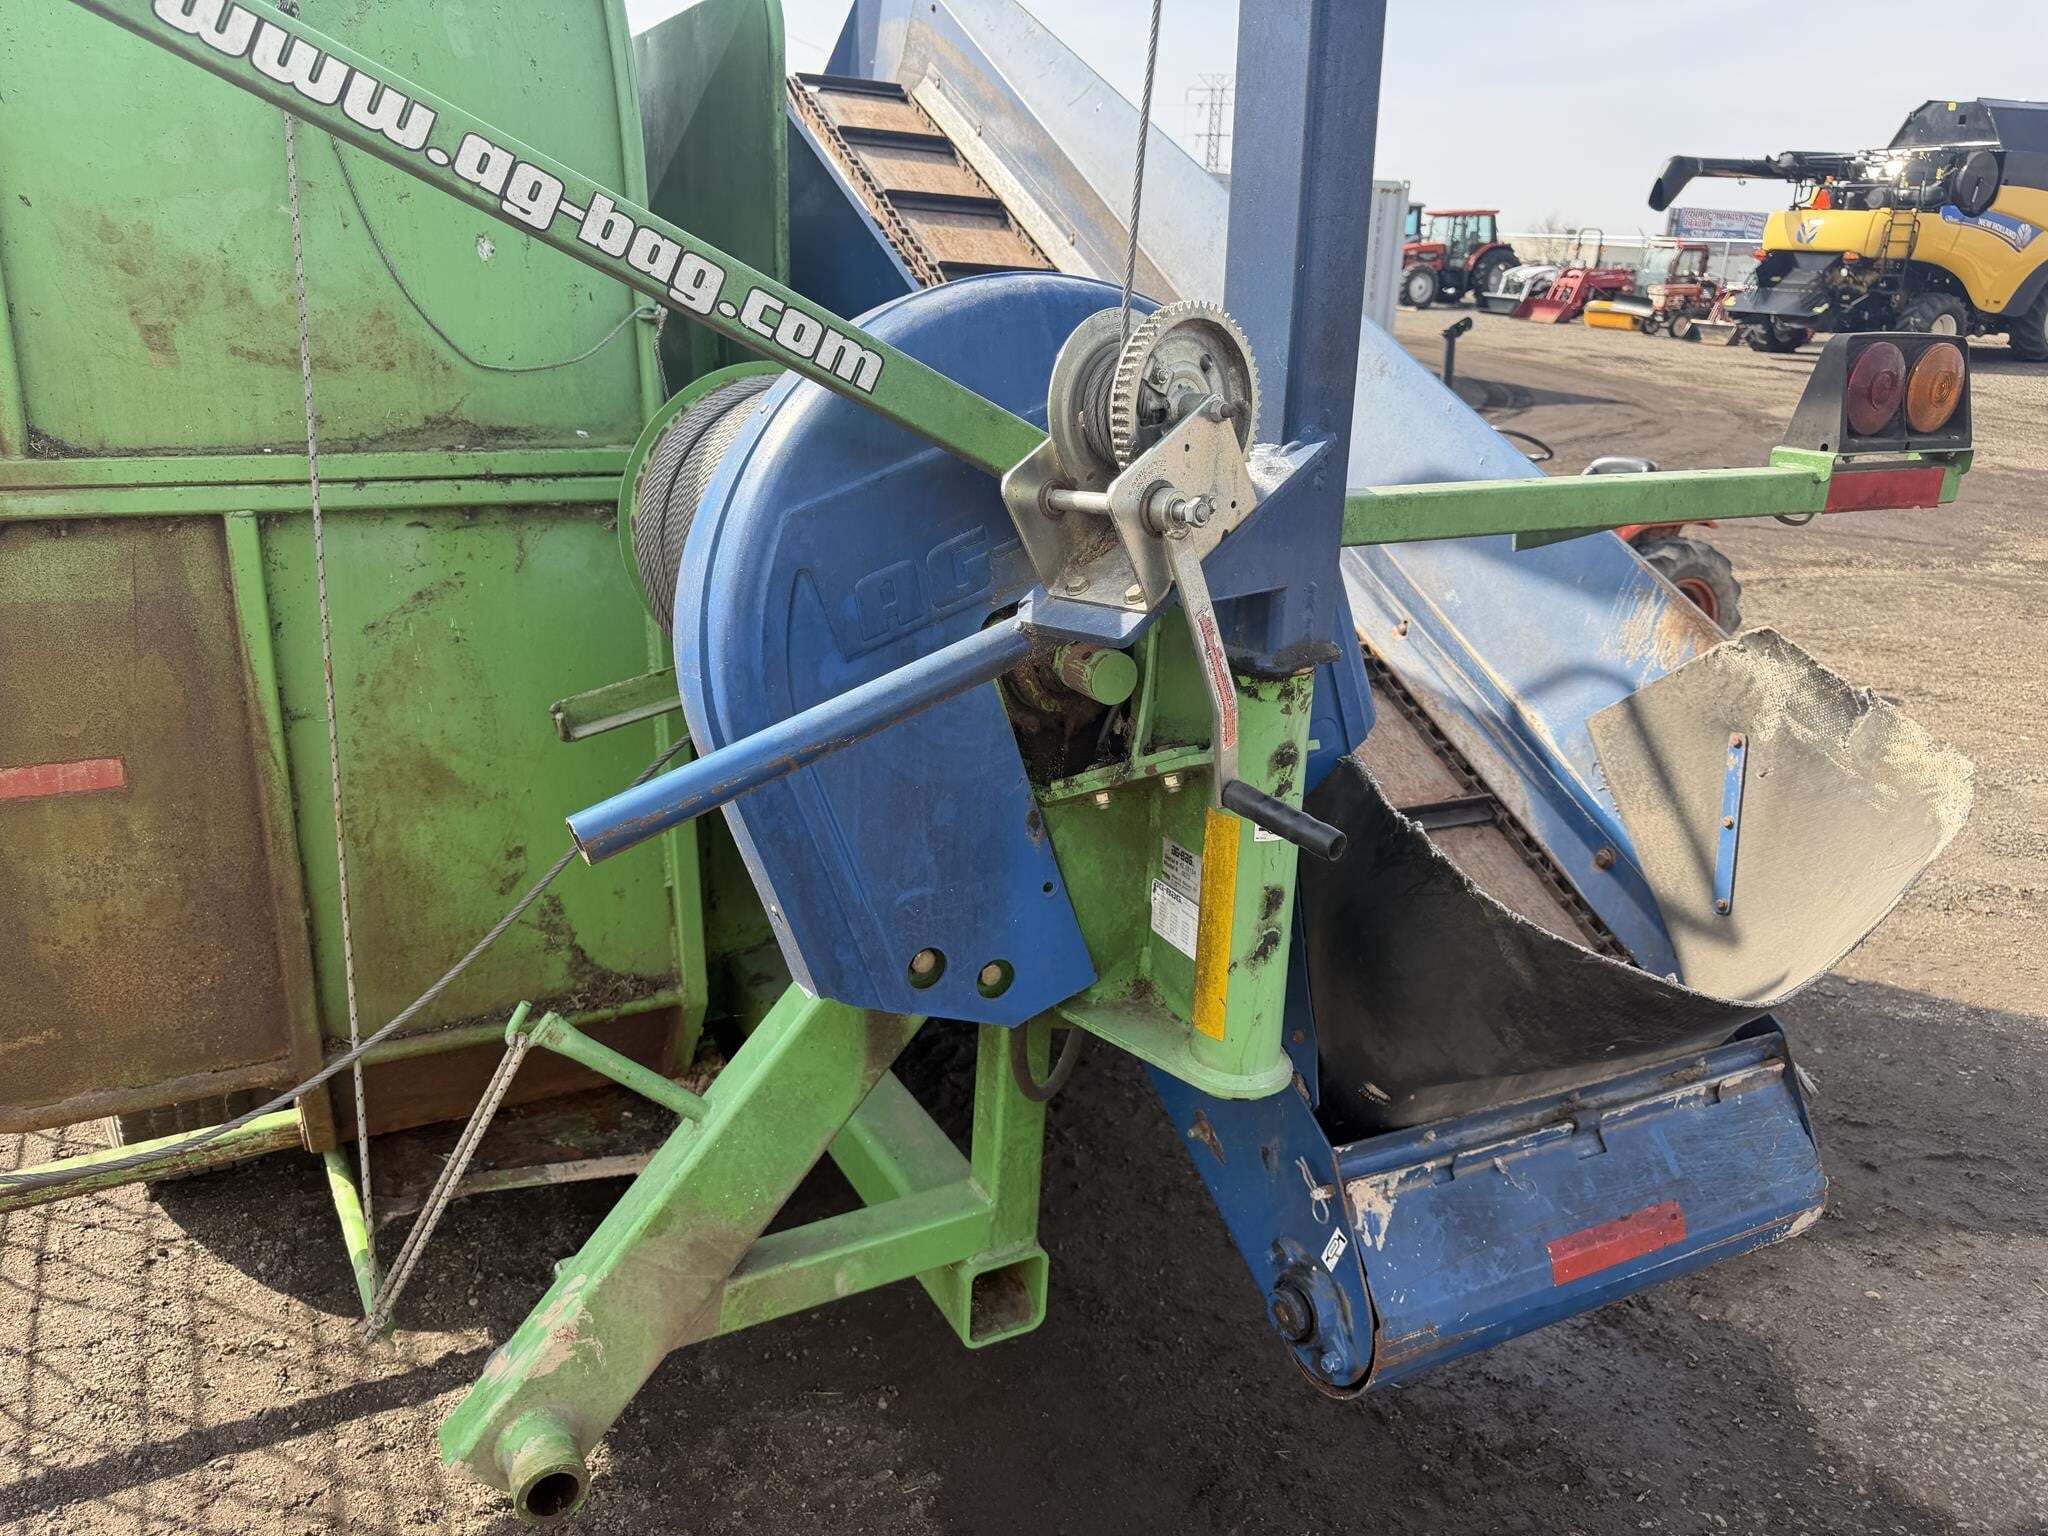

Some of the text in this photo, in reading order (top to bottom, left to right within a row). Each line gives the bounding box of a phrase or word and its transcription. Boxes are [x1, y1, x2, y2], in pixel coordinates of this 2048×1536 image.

[153, 0, 884, 393] www.ag-bag.com
[1978, 217, 2017, 239] NEW HOLLAND
